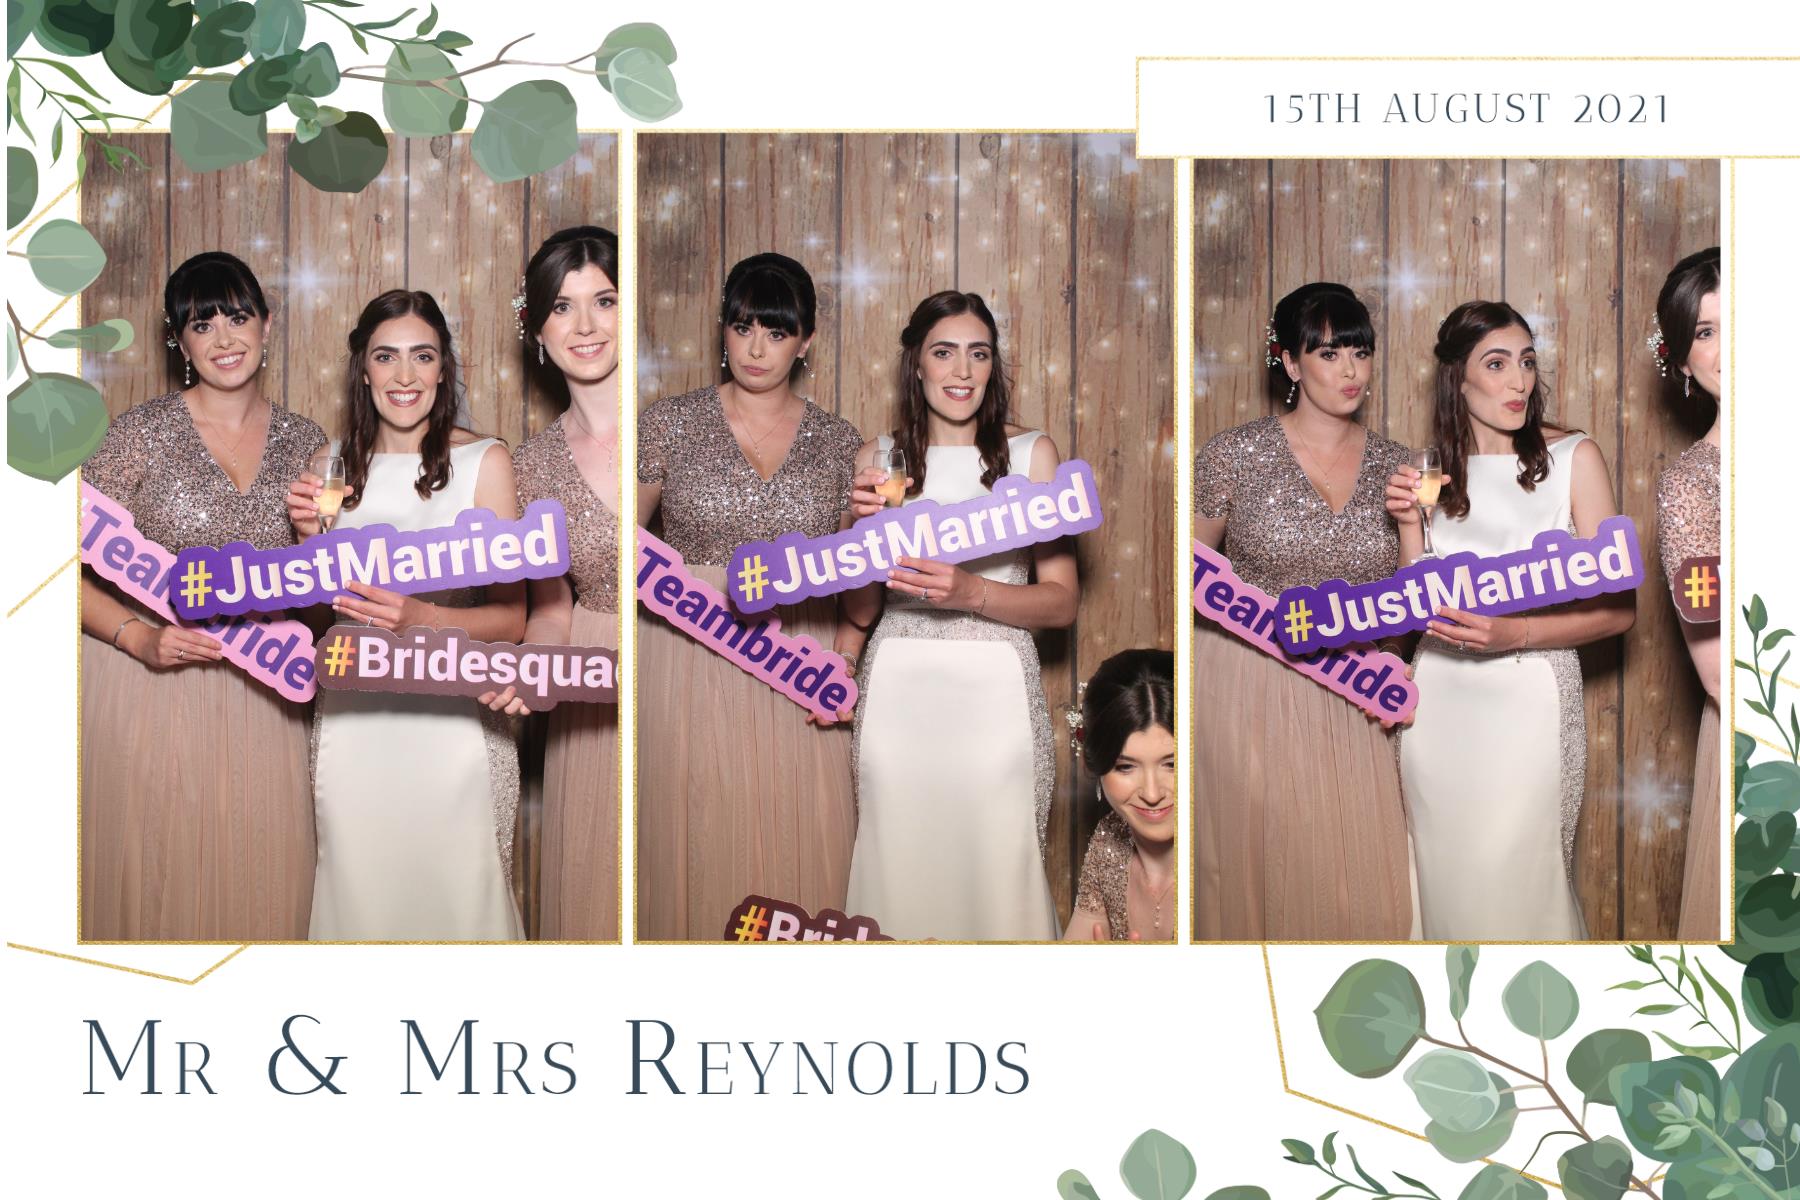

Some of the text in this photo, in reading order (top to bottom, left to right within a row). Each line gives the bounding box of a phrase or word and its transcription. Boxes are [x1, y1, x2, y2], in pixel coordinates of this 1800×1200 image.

[179, 513, 559, 608] #JustMarried
[737, 472, 1093, 602] #JustMarried
[1283, 529, 1634, 644] #JustMarried
[324, 635, 618, 697] #Bridesqua
